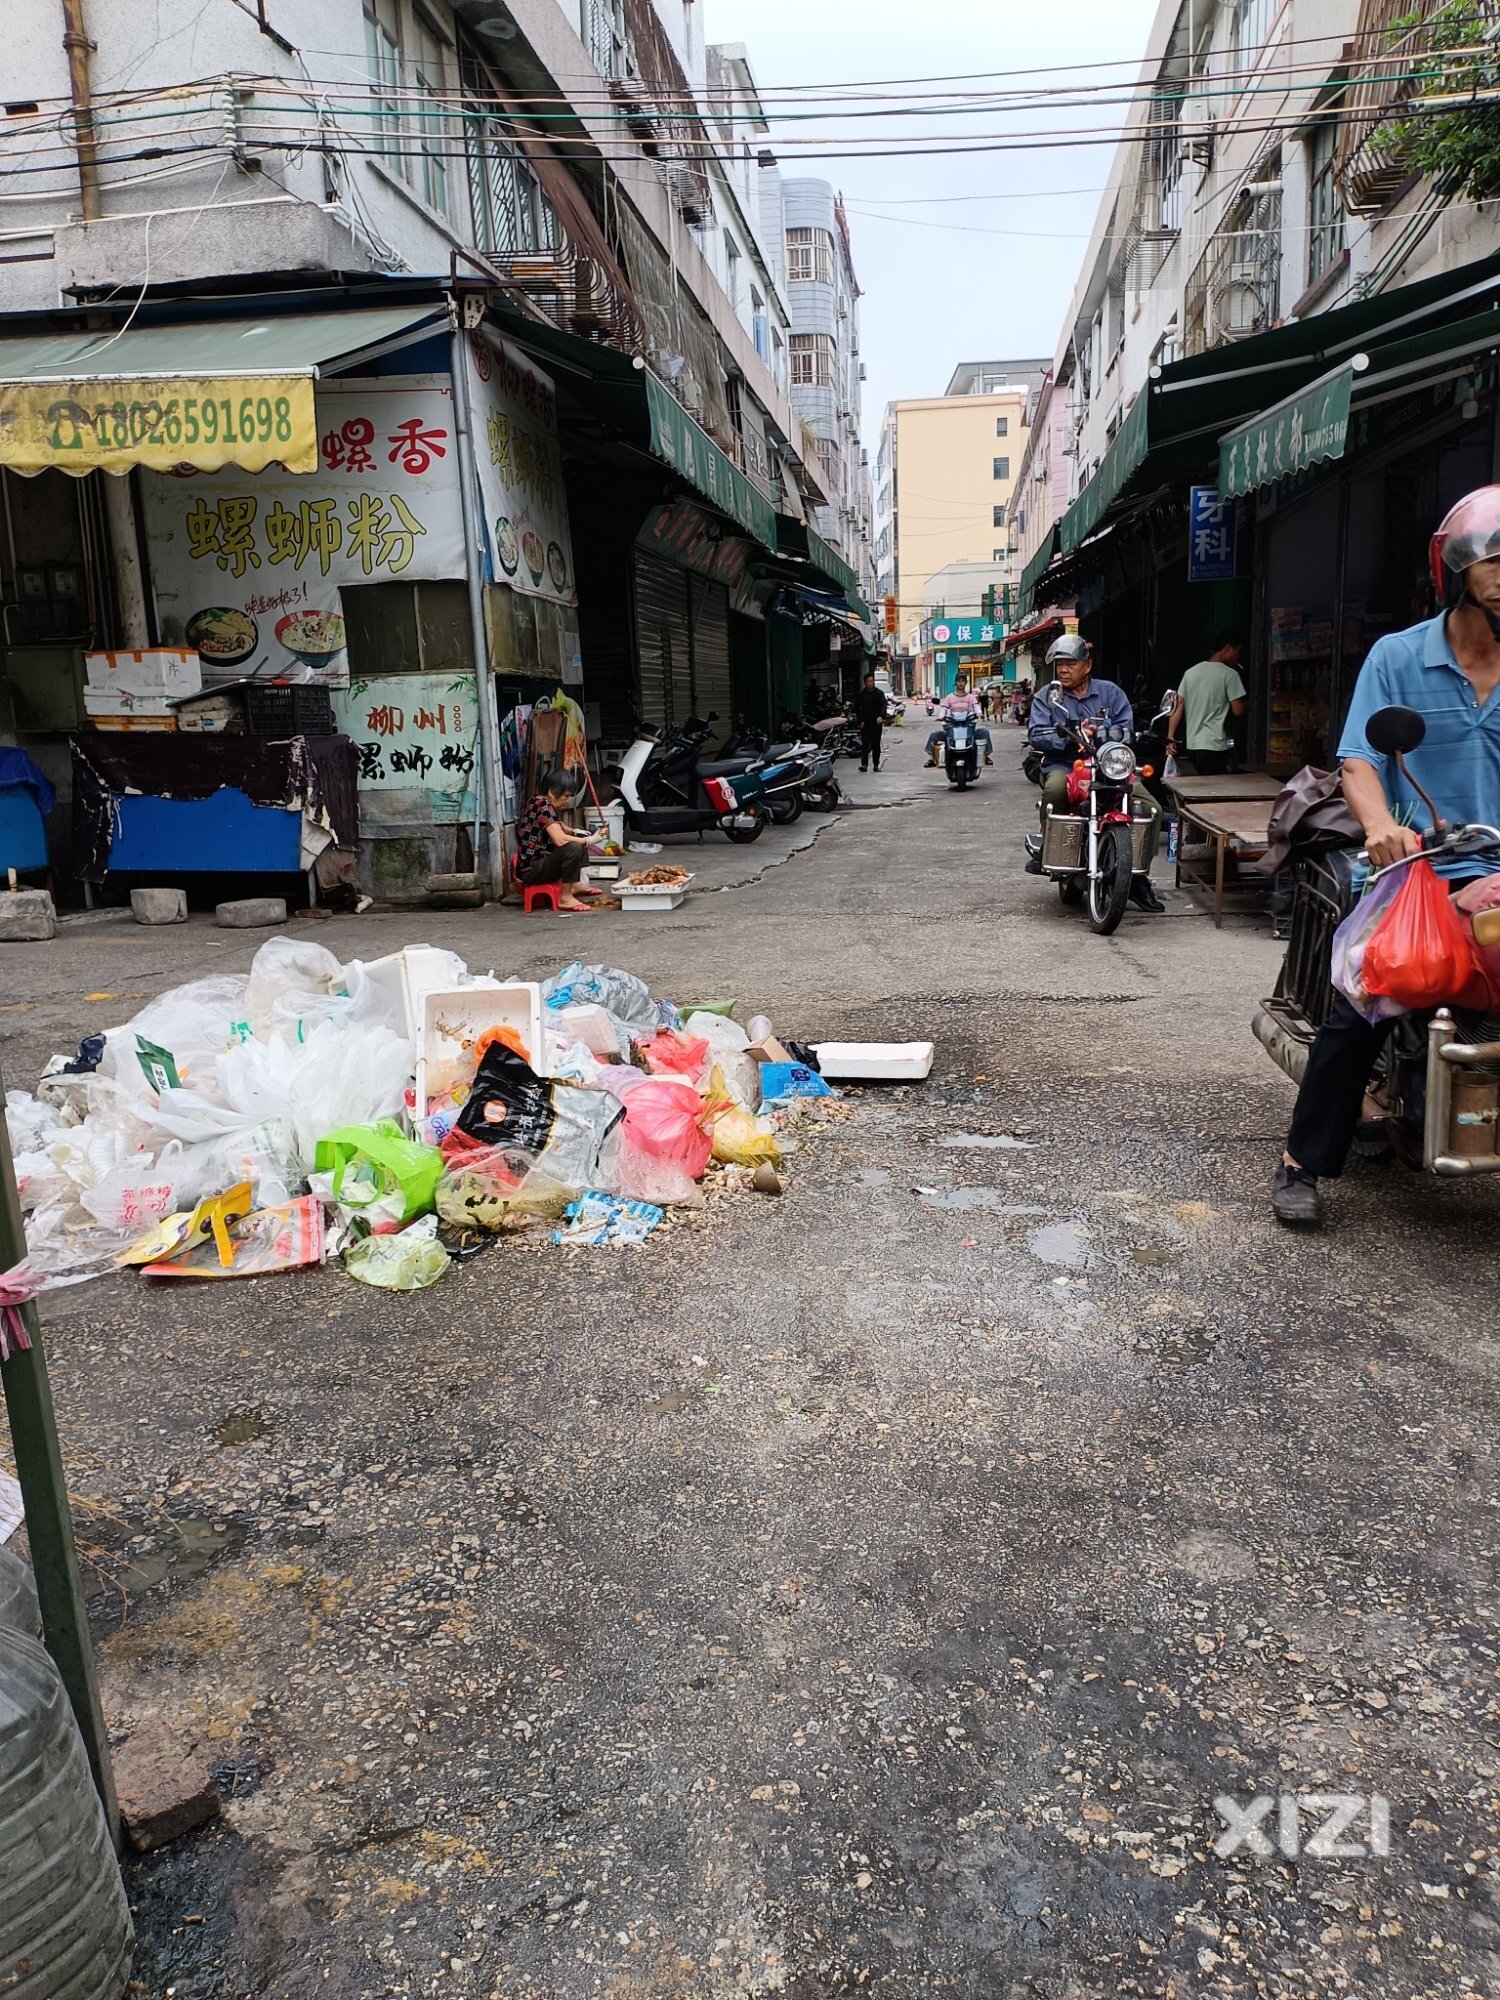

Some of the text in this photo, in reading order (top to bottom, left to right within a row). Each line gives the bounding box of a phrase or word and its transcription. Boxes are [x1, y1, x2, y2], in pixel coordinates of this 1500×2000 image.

[95, 396, 292, 448] 18026591698
[186, 493, 427, 578] 螺蛳粉
[1194, 490, 1232, 562] 牙科
[957, 625, 994, 642] 保益
[365, 704, 447, 737] 柳州
